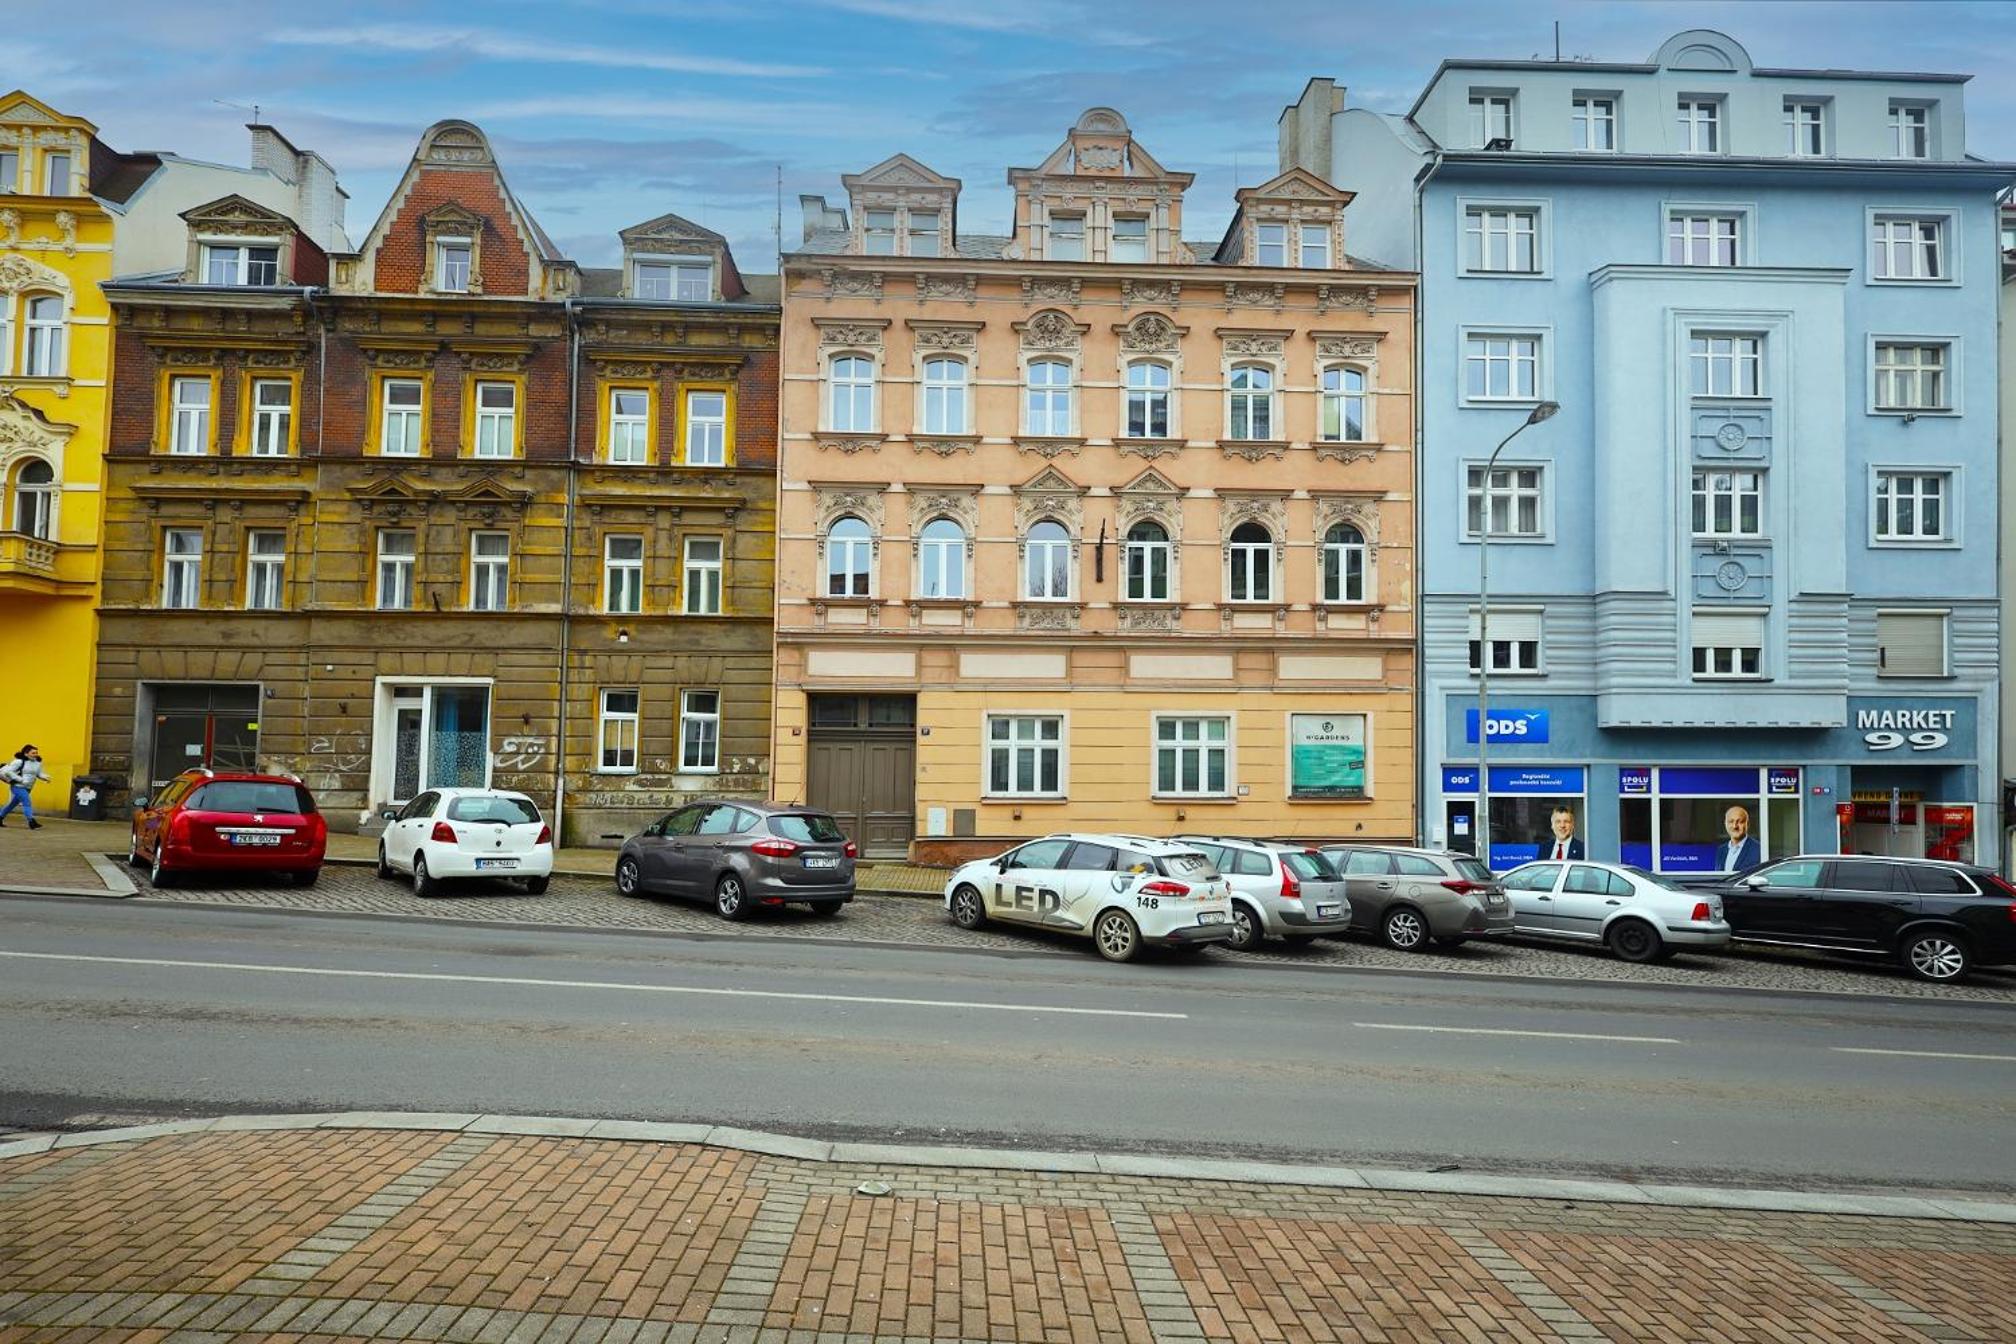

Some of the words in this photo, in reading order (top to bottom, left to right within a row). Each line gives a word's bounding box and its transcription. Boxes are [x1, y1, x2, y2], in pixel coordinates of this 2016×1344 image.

[1485, 719, 1528, 735] ODS
[1857, 709, 1956, 730] MARKET
[1864, 731, 1949, 751] 99
[1451, 776, 1469, 784] ODS
[1180, 858, 1204, 872] LED
[995, 883, 1060, 914] LED
[1136, 896, 1159, 910] 148
